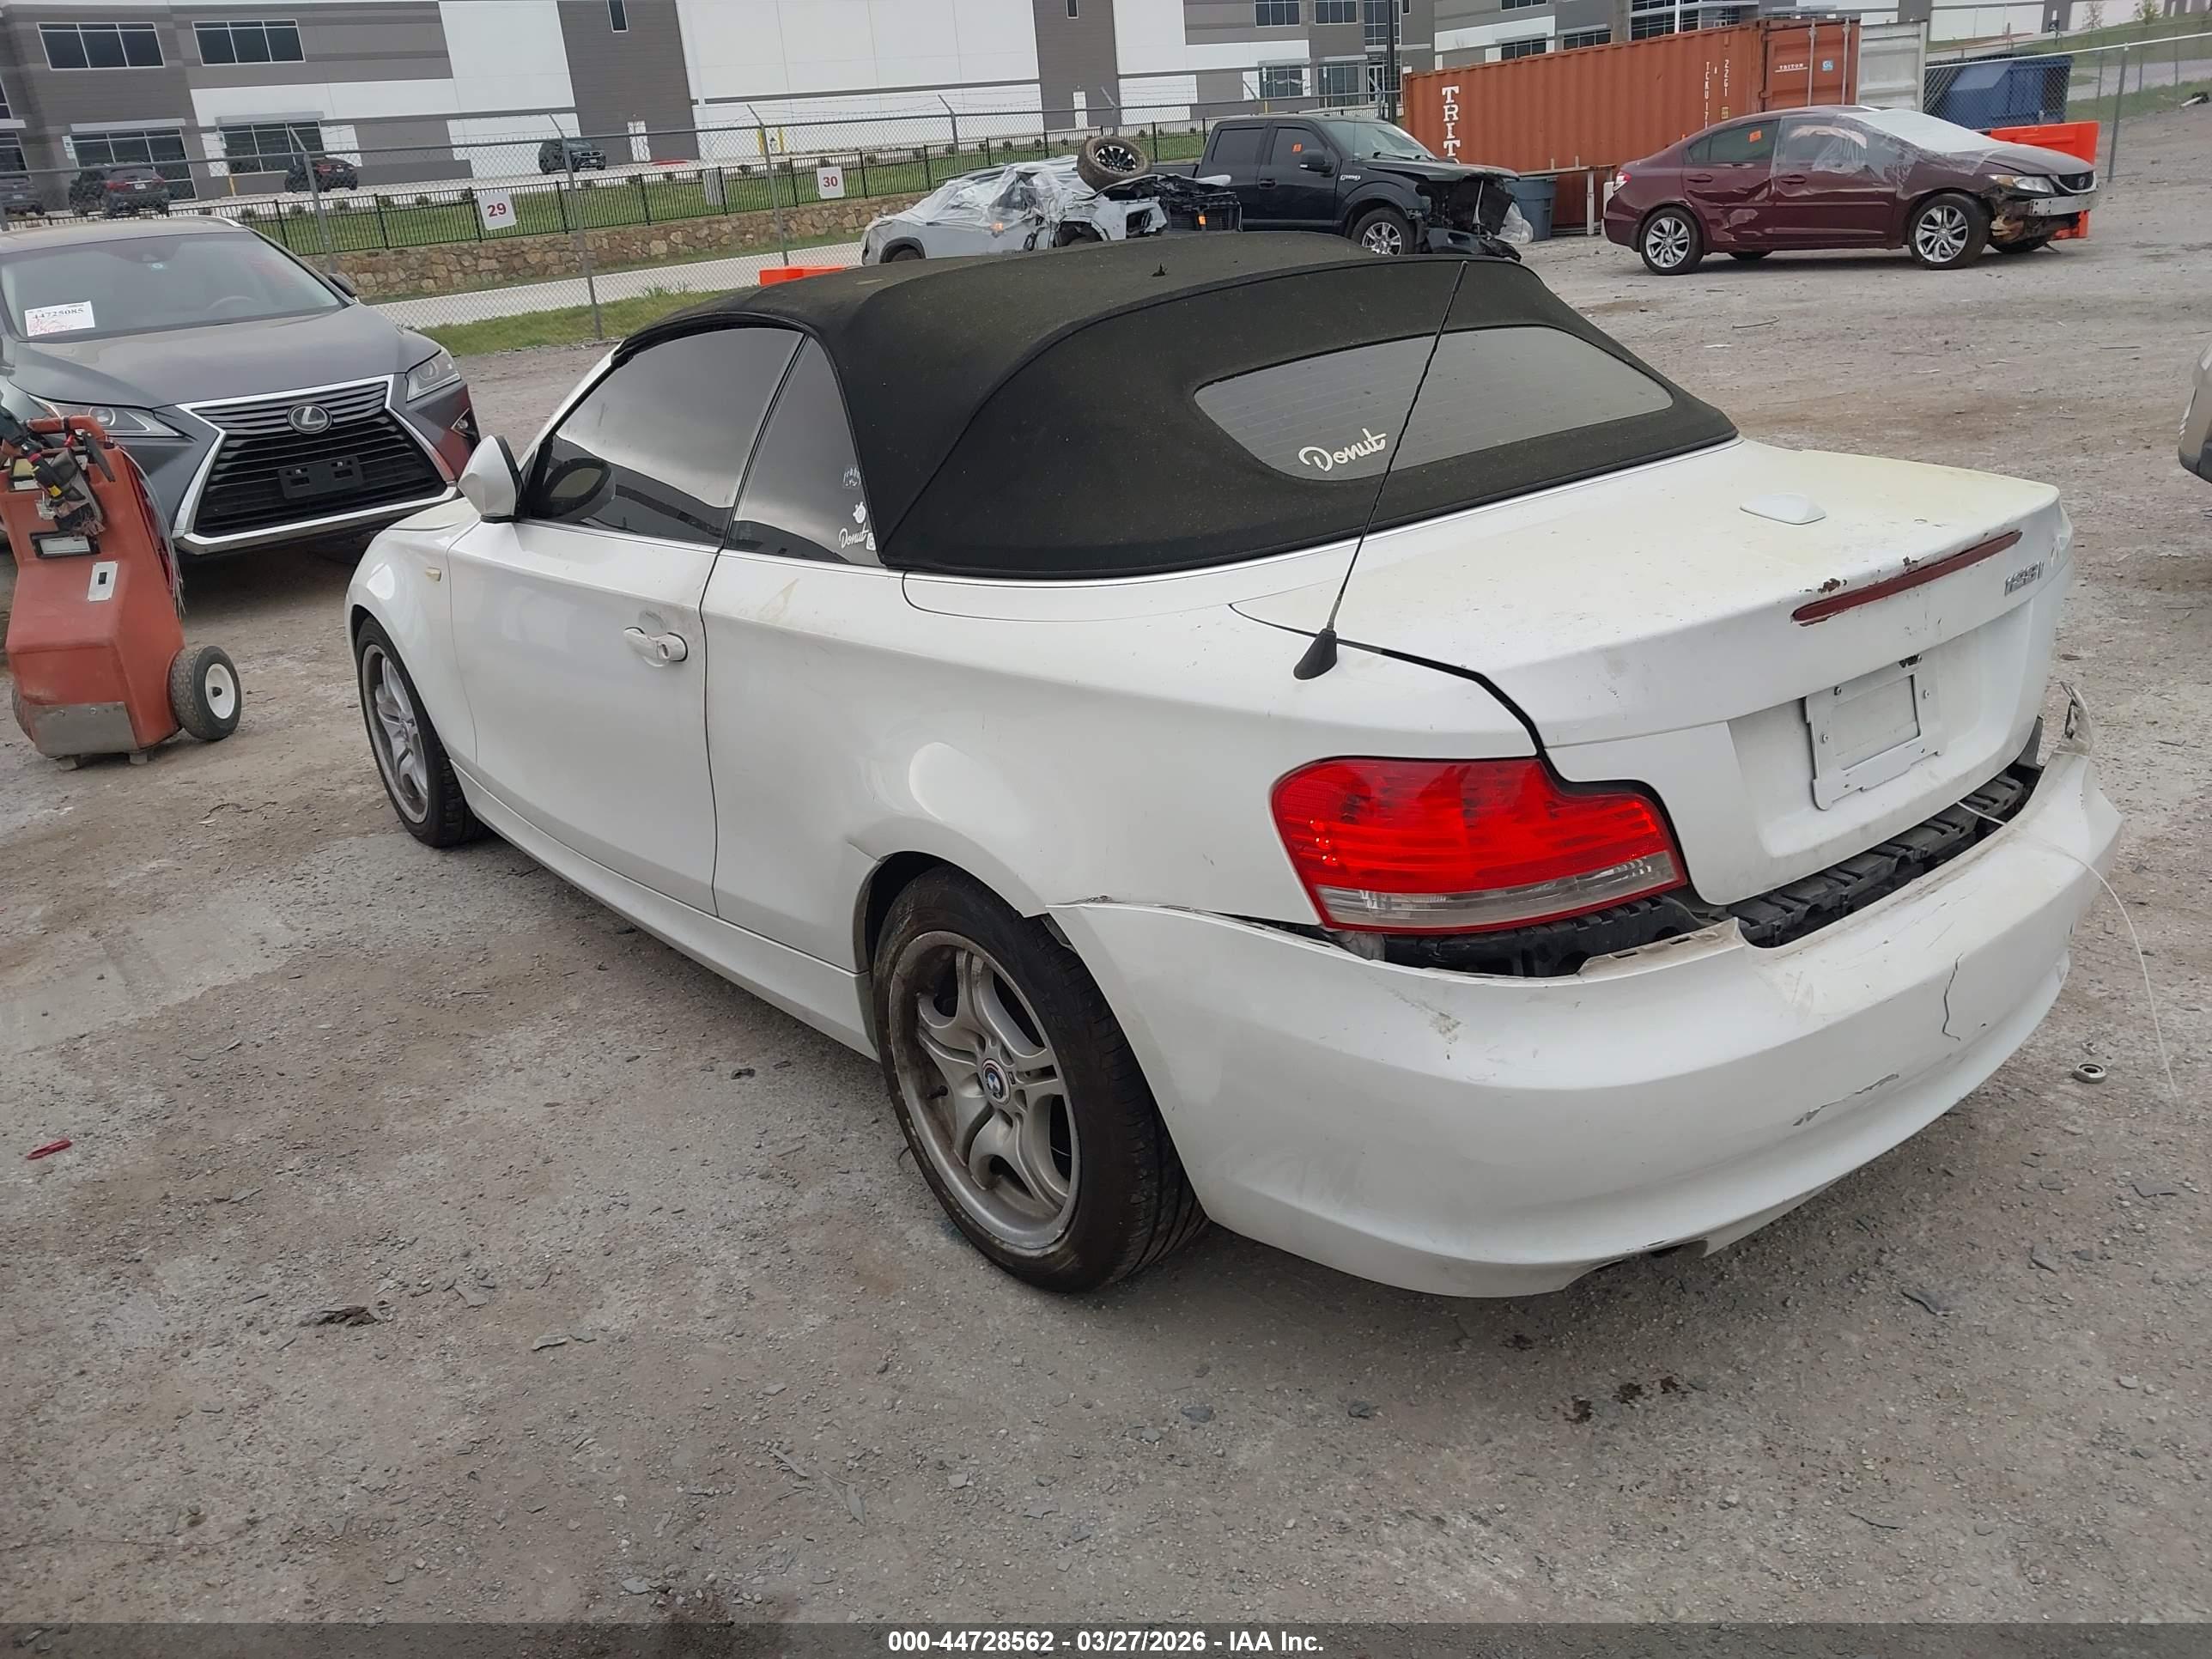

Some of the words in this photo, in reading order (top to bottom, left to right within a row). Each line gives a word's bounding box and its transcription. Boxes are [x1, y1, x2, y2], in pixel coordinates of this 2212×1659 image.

[1442, 86, 1461, 164] TRIT
[823, 176, 838, 187] 30
[487, 203, 507, 217] 29
[1297, 428, 1387, 472] Donut
[838, 522, 869, 550] Donut
